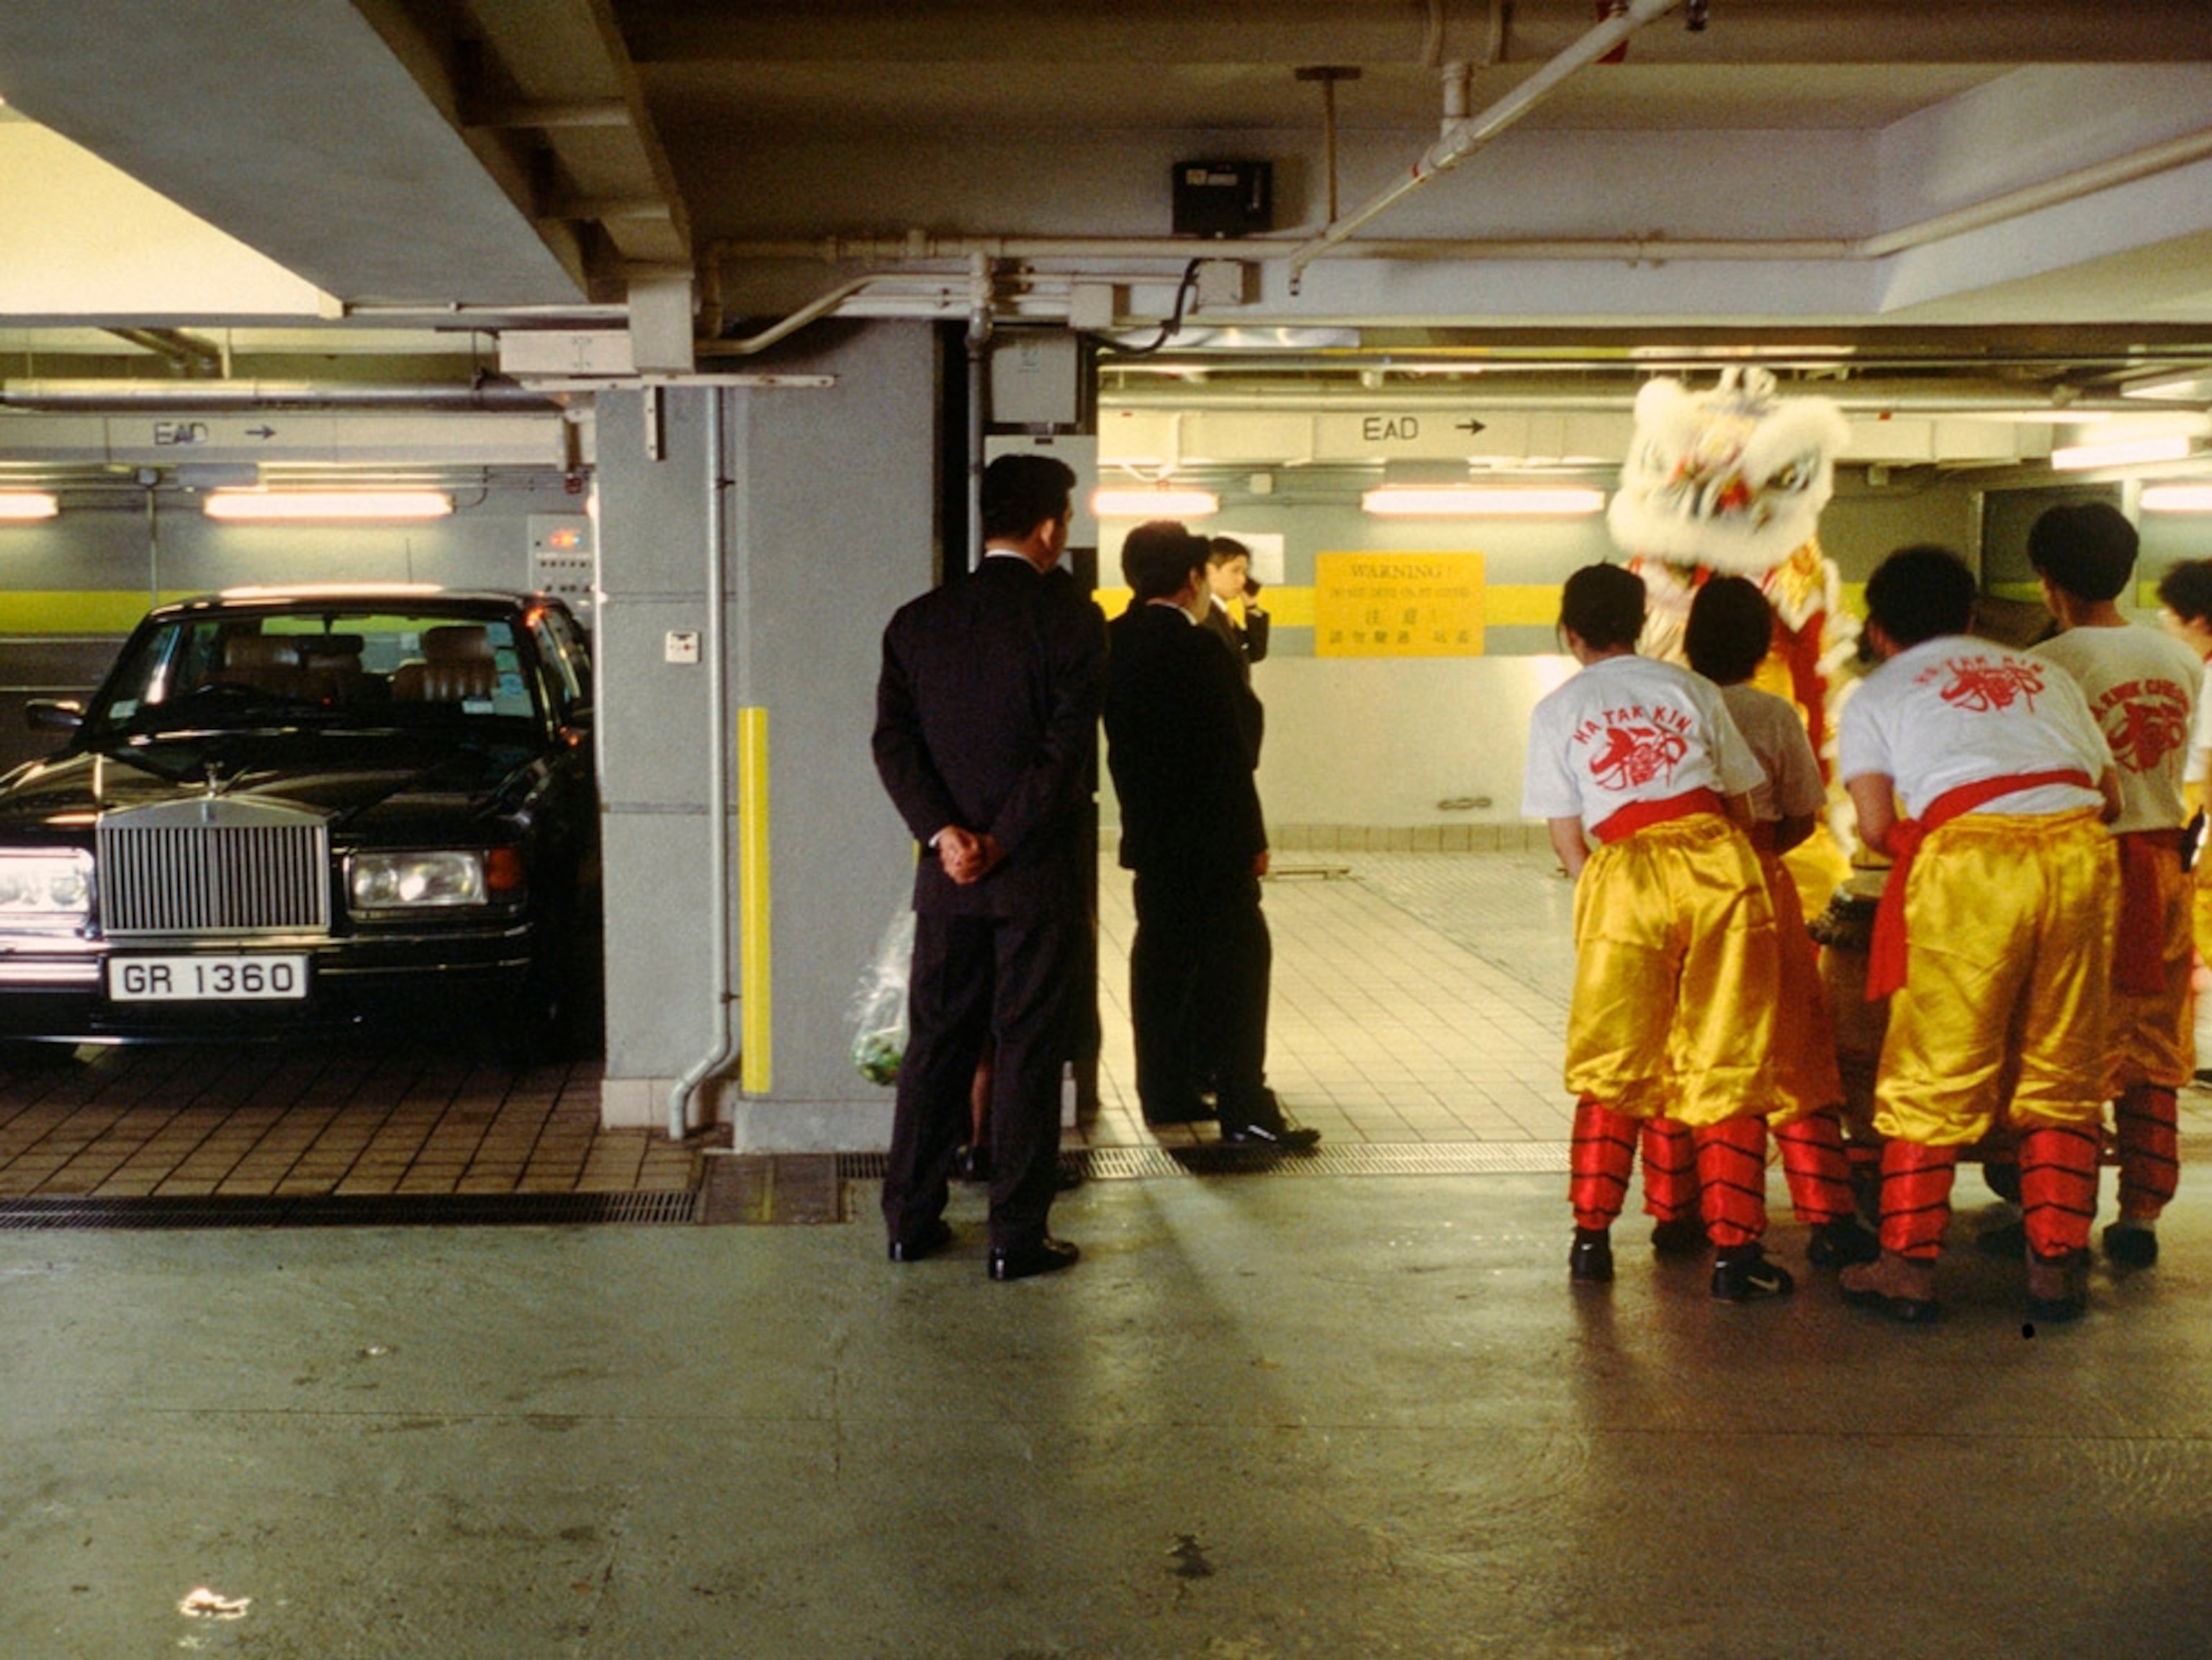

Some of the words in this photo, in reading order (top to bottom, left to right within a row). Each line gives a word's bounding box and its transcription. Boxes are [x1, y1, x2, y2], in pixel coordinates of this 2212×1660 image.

[1362, 417, 1419, 441] EAD
[1350, 564, 1442, 579] WARNING
[1573, 720, 1602, 745] HA
[1601, 705, 1644, 725] TAK
[1653, 705, 1692, 734] KIN
[123, 965, 173, 994] GR
[196, 963, 294, 994] 1360
